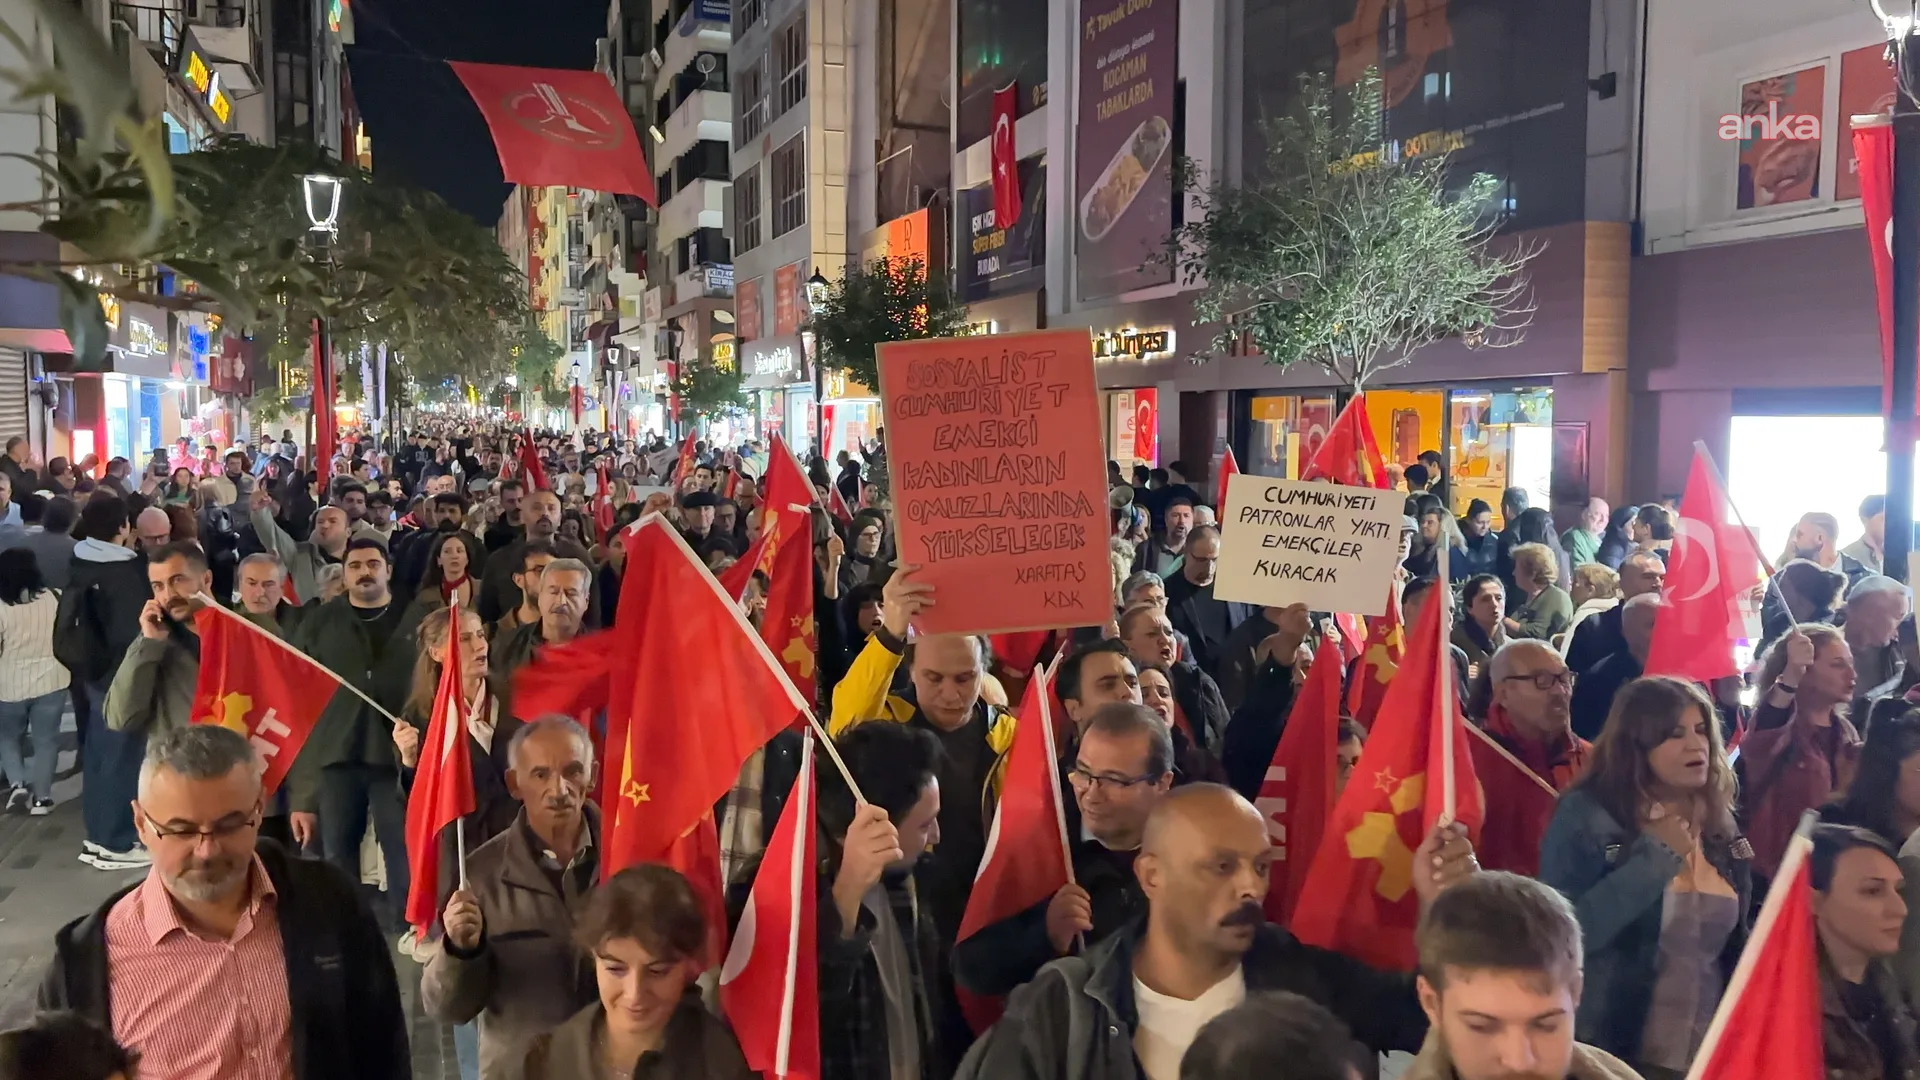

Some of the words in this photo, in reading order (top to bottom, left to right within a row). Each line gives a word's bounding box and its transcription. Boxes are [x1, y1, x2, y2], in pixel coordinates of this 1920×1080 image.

[1103, 52, 1147, 92] KOCAMAN
[1096, 77, 1154, 122] TABAKLARDA
[977, 255, 1000, 276] BURADA
[907, 349, 1056, 391] SOSYALİST
[903, 451, 1066, 490] KADINLARIN
[907, 490, 1095, 526] OMUZLARINDA
[1239, 506, 1336, 533] PATRONLAR
[920, 523, 1086, 563] YÜKSELECEK
[1261, 534, 1363, 562] EMEKÇİLER
[1253, 559, 1338, 584] KURACAK
